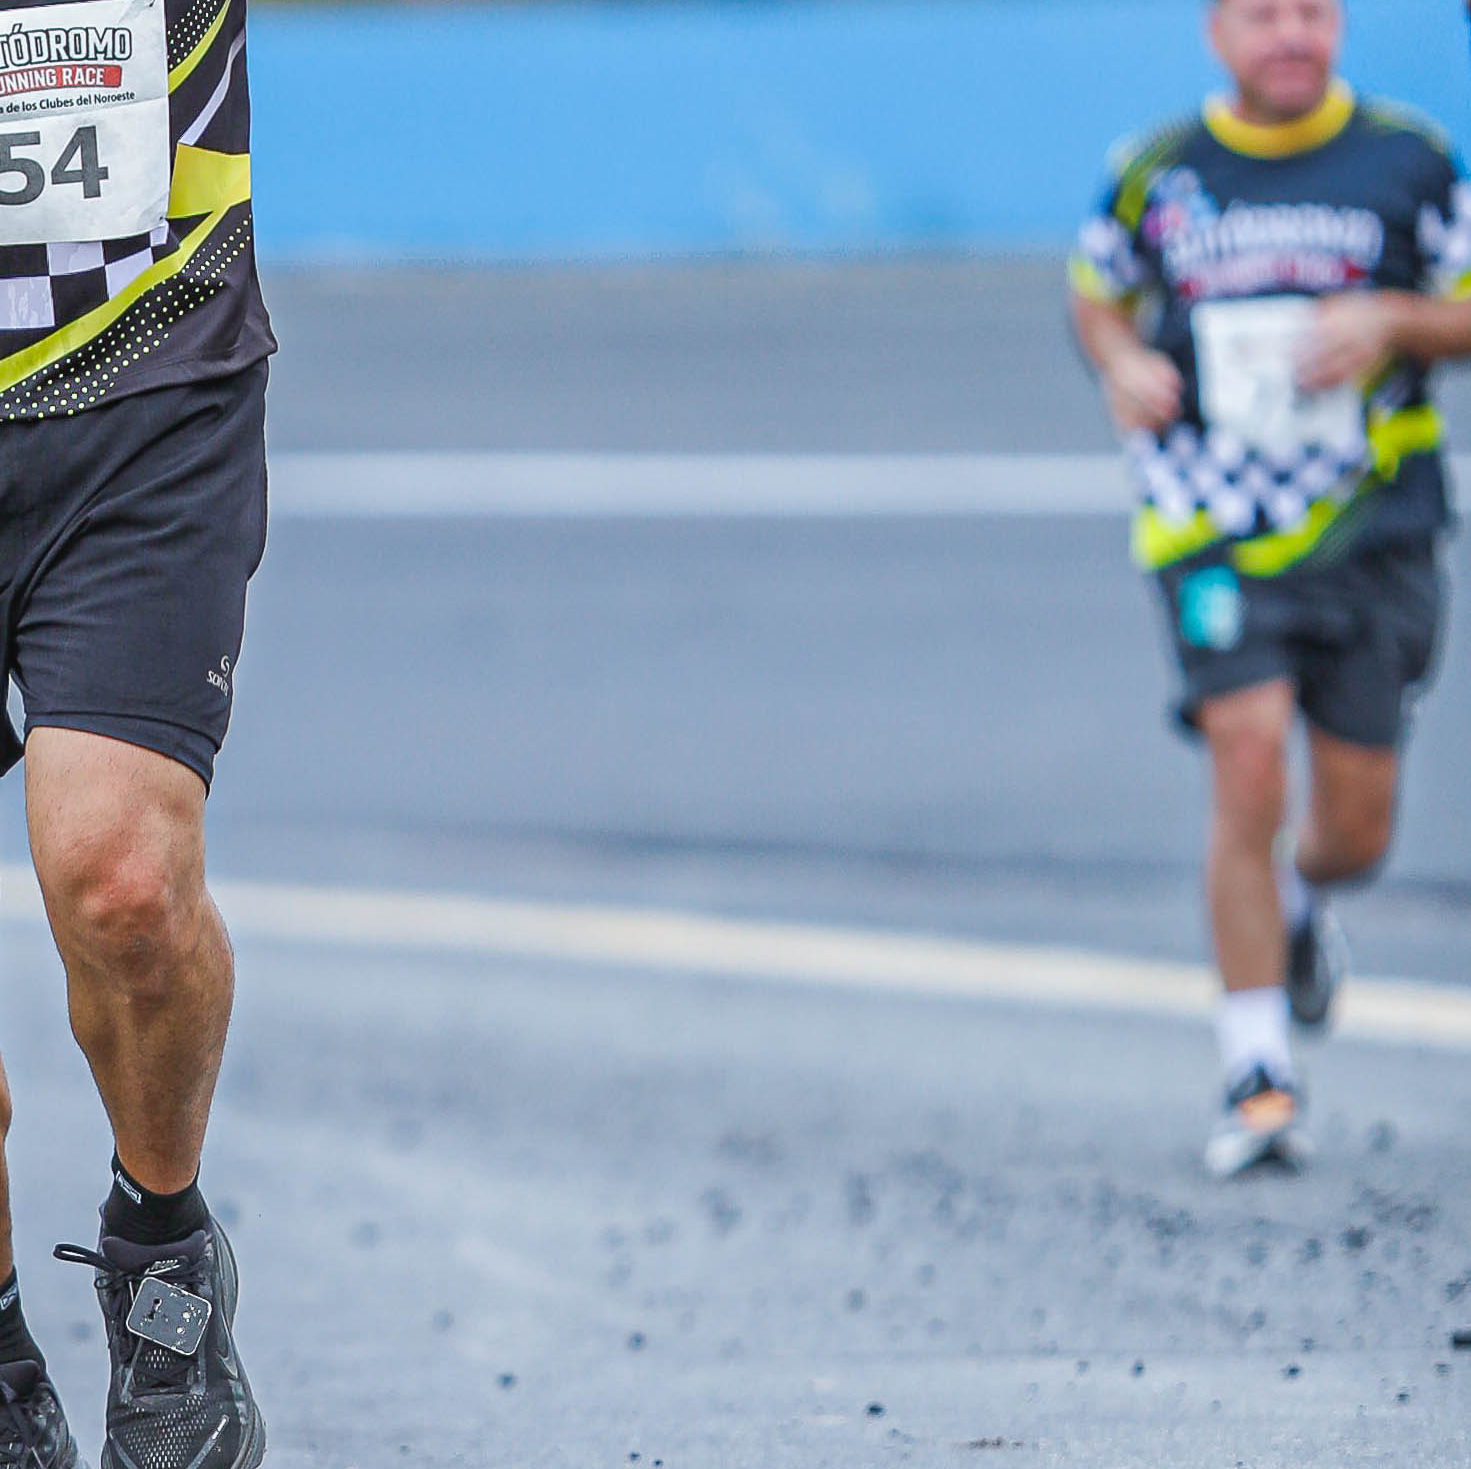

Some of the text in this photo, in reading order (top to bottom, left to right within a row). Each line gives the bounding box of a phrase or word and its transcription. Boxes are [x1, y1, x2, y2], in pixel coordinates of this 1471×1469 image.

[62, 67, 105, 87] RACE
[6, 100, 20, 114] de
[22, 99, 38, 112] los
[39, 95, 74, 110] Clubes
[76, 93, 93, 107] del
[94, 91, 136, 105] Noroeste
